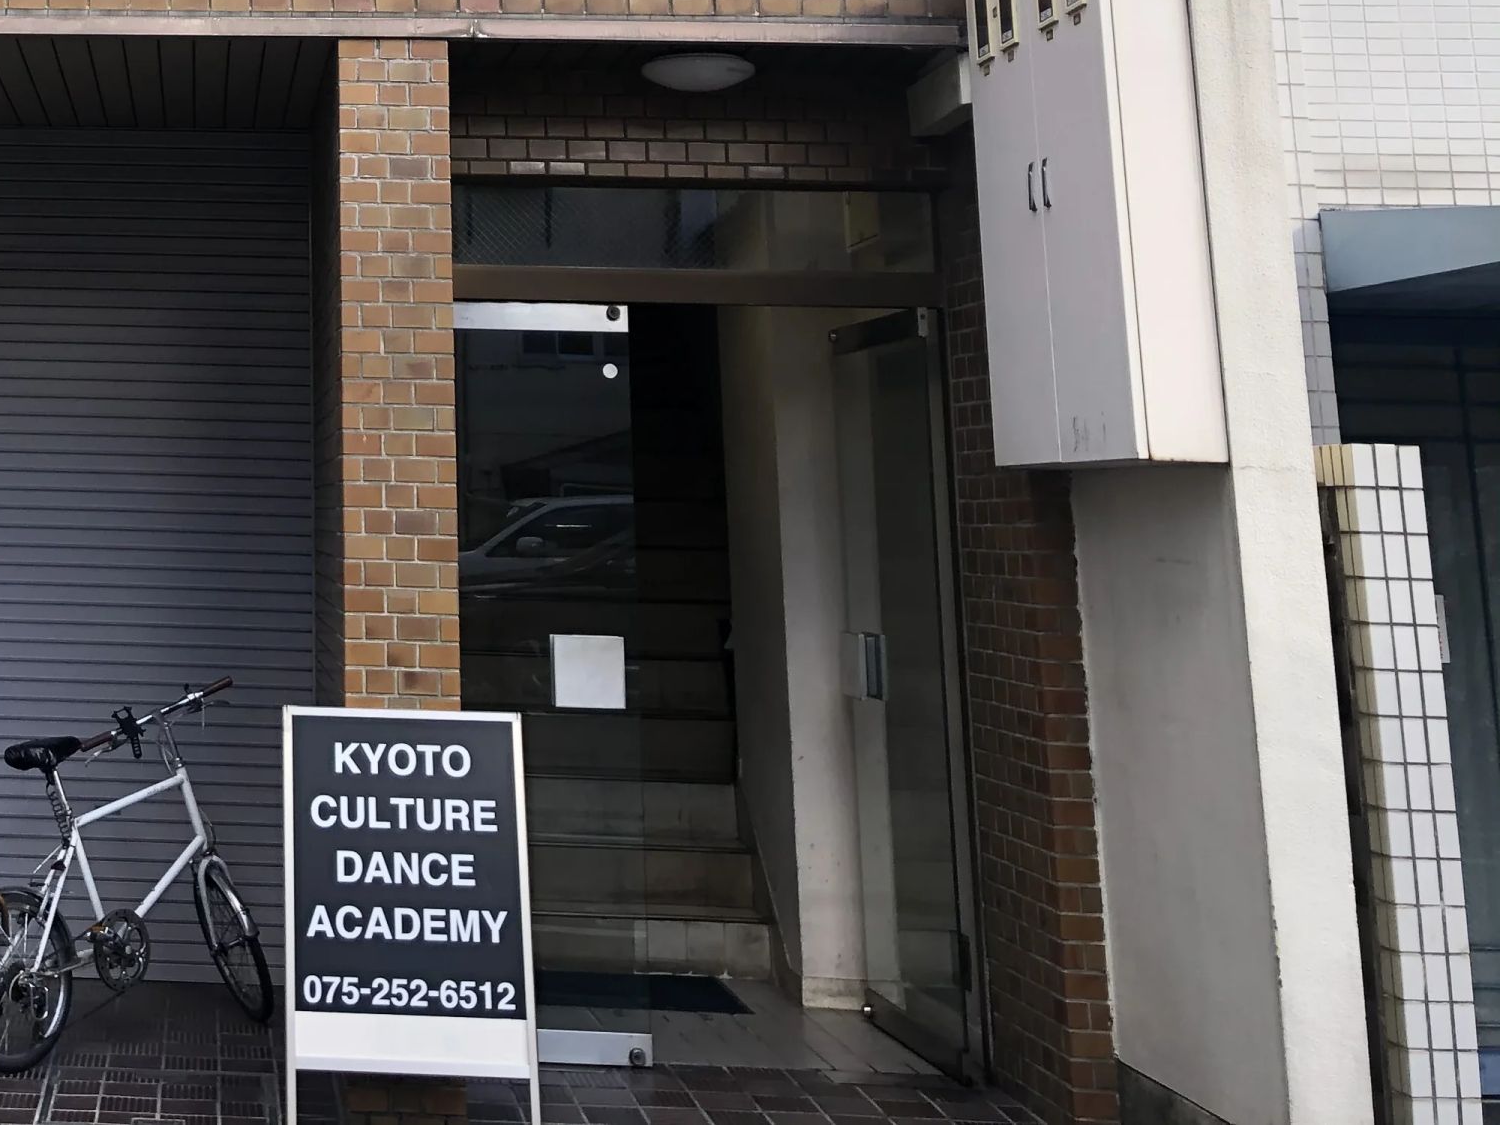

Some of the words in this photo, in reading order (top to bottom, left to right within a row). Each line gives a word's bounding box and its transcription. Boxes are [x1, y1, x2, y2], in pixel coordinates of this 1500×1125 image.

[334, 742, 471, 778] KYOTO
[310, 795, 498, 832] CULTURE
[336, 850, 476, 886] DANCE
[306, 905, 508, 944] ACADEMY
[303, 975, 517, 1011] 075-252-6512
